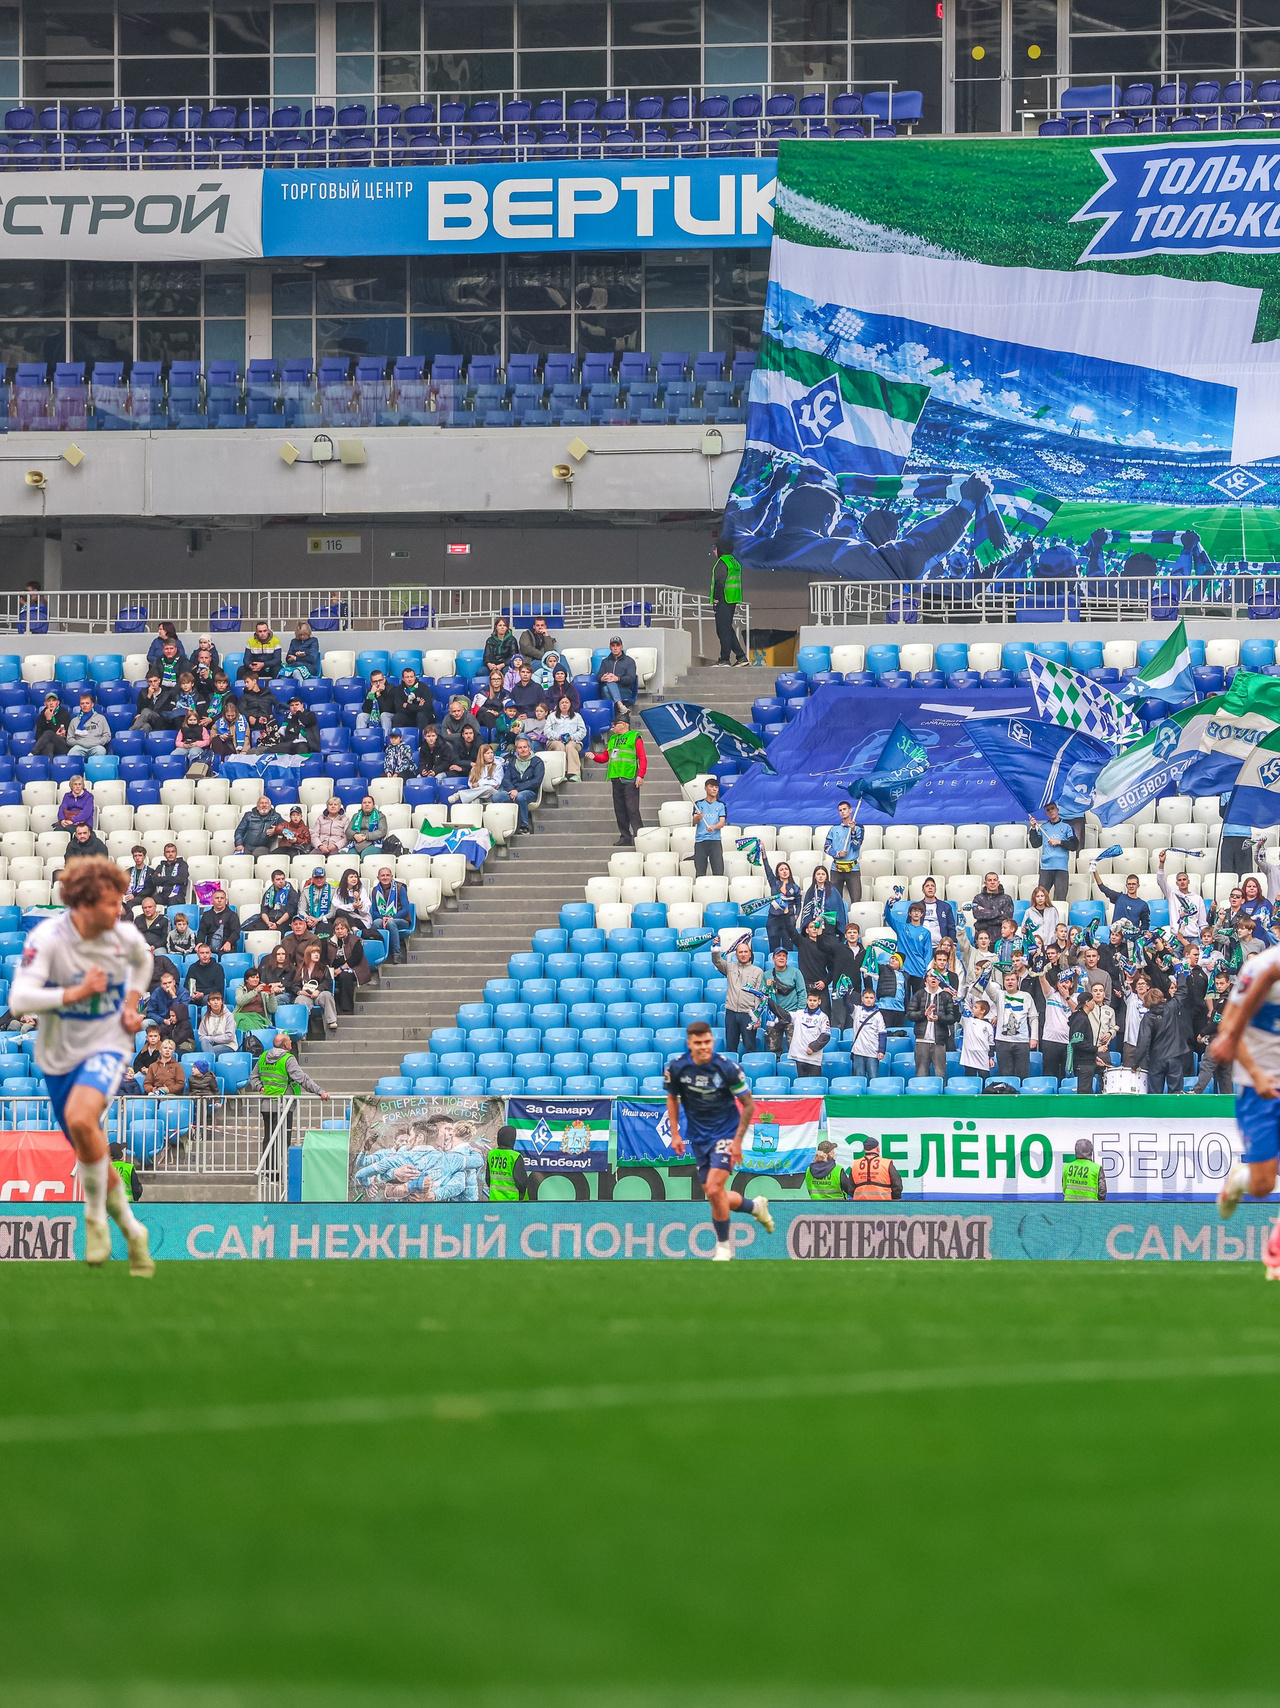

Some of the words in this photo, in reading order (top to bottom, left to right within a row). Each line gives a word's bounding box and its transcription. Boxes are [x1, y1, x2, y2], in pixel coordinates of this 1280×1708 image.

[281, 180, 360, 200] ТОРГОВЫЙ
[364, 180, 413, 200] ЦЕНТР
[0, 183, 230, 235] СТРОЙ
[326, 540, 342, 550] 116
[380, 1097, 428, 1112] ВПЕРЁД
[432, 1096, 439, 1105] К
[442, 1096, 488, 1112] ПОБЕДЕ
[525, 1104, 543, 1114] За
[545, 1105, 594, 1116] Самару
[382, 1107, 428, 1123] FORWARD
[430, 1106, 442, 1114] TO
[523, 1157, 536, 1166] За
[540, 1157, 592, 1168] Победу!
[1068, 1165, 1089, 1179] 9742
[289, 1214, 505, 1260] НЕЖНЫЙ
[520, 1222, 756, 1259] СПОНСОР
[792, 1219, 987, 1260] СЕНЕЖСКАЯ
